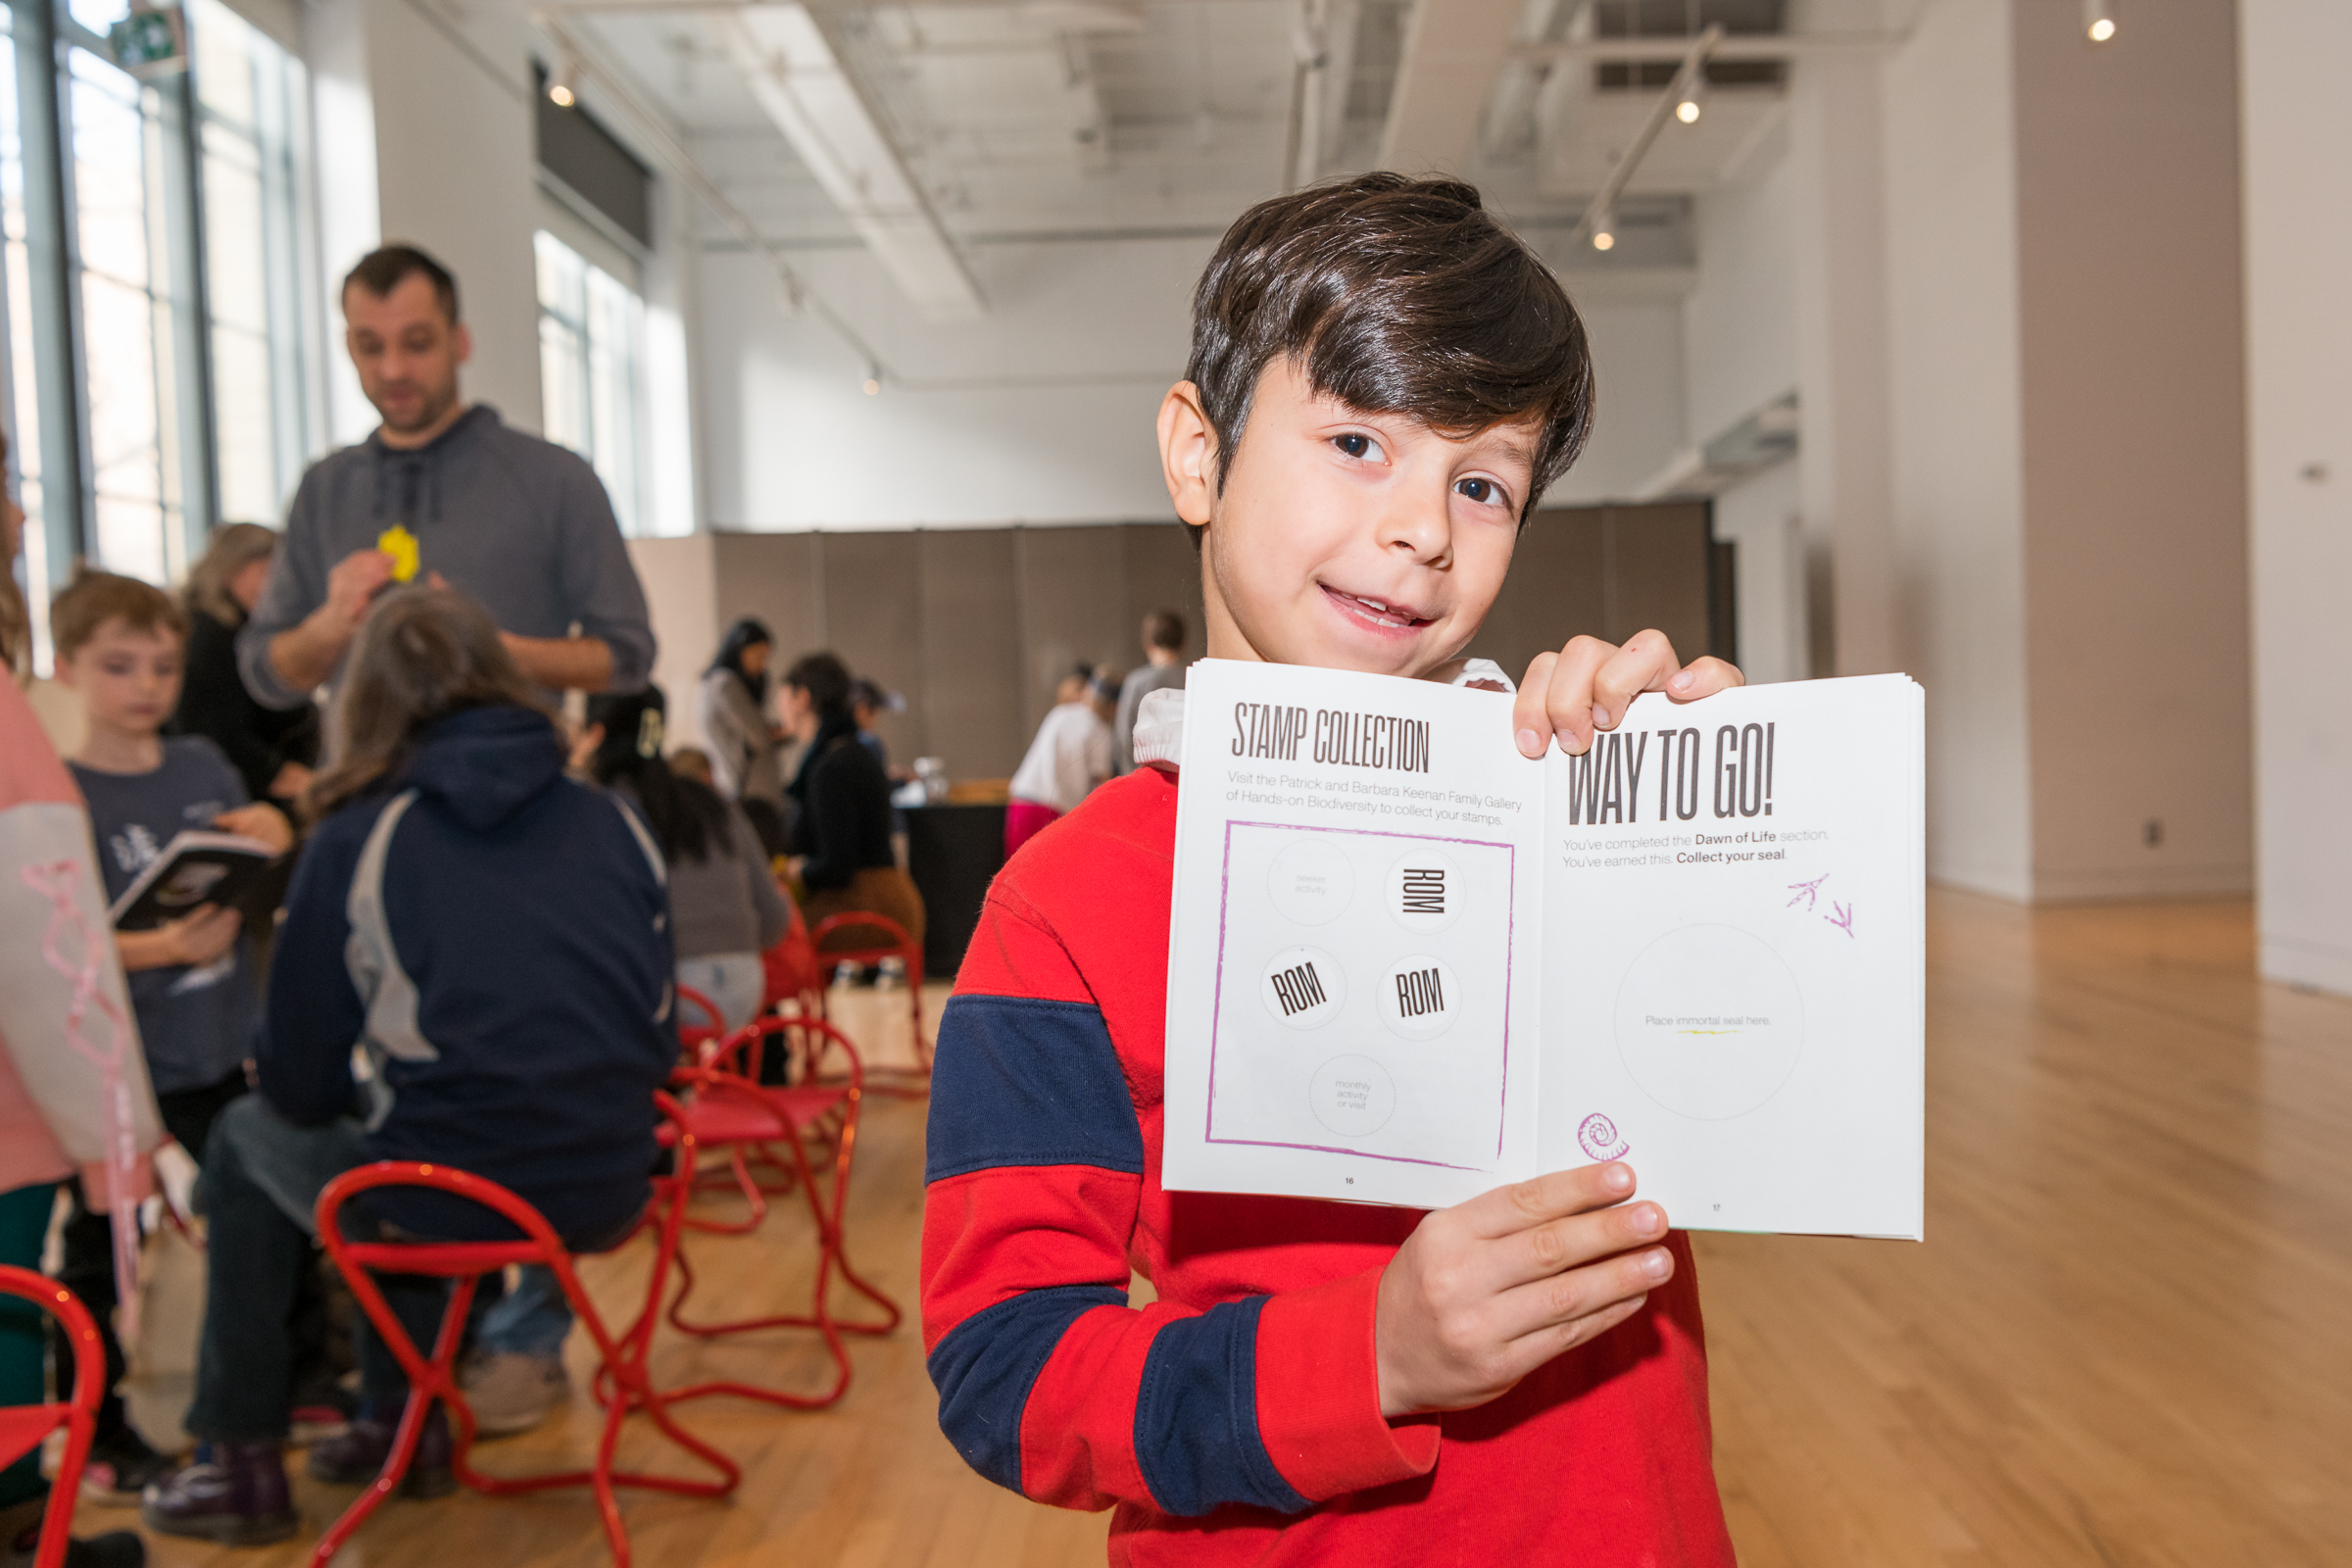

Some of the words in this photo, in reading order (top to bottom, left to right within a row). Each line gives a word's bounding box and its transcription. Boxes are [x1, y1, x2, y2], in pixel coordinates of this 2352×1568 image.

[1231, 702, 1308, 760] STAMP
[1313, 709, 1430, 773] COLLECTION
[1569, 731, 1648, 825] WAY
[1657, 727, 1700, 821] TO
[1713, 722, 1775, 818] GO!
[1228, 770, 1253, 785] Visit
[1256, 773, 1277, 787] the
[1279, 774, 1322, 791] Patrick
[1324, 781, 1349, 793] and
[1351, 781, 1399, 797] Barbara
[1402, 786, 1446, 802] Keenan
[1448, 791, 1483, 808] Family
[1485, 796, 1523, 812] Gallery
[1226, 789, 1240, 802] of
[1241, 790, 1304, 807] Hands-on
[1306, 795, 1378, 815] Biodiversity
[1380, 803, 1393, 814] to
[1395, 805, 1433, 818] collect
[1435, 809, 1460, 821] your
[1461, 811, 1503, 826] stamps.
[1562, 839, 1602, 851] You've
[1604, 835, 1669, 851] completed
[1672, 835, 1692, 847] the
[1695, 833, 1733, 845] Dawn
[1735, 831, 1749, 843] of
[1751, 830, 1777, 843] Life
[1780, 829, 1830, 843] section.
[1562, 856, 1602, 868] You've
[1604, 854, 1647, 867] earned
[1649, 854, 1674, 865] this.
[1677, 852, 1723, 863] Collect
[1725, 852, 1755, 864] your
[1296, 873, 1328, 884] seeker
[1295, 884, 1328, 897] activity
[1402, 868, 1446, 914] ROM
[1271, 961, 1328, 1016] ROM
[1396, 967, 1445, 1018] ROM
[1645, 1015, 1674, 1025] Place
[1676, 1015, 1720, 1025] immortal
[1722, 1015, 1744, 1025] seal
[1745, 1015, 1772, 1025] here.
[1335, 1080, 1372, 1093] monthly
[1337, 1090, 1369, 1102] activity
[1348, 1101, 1367, 1110] visit
